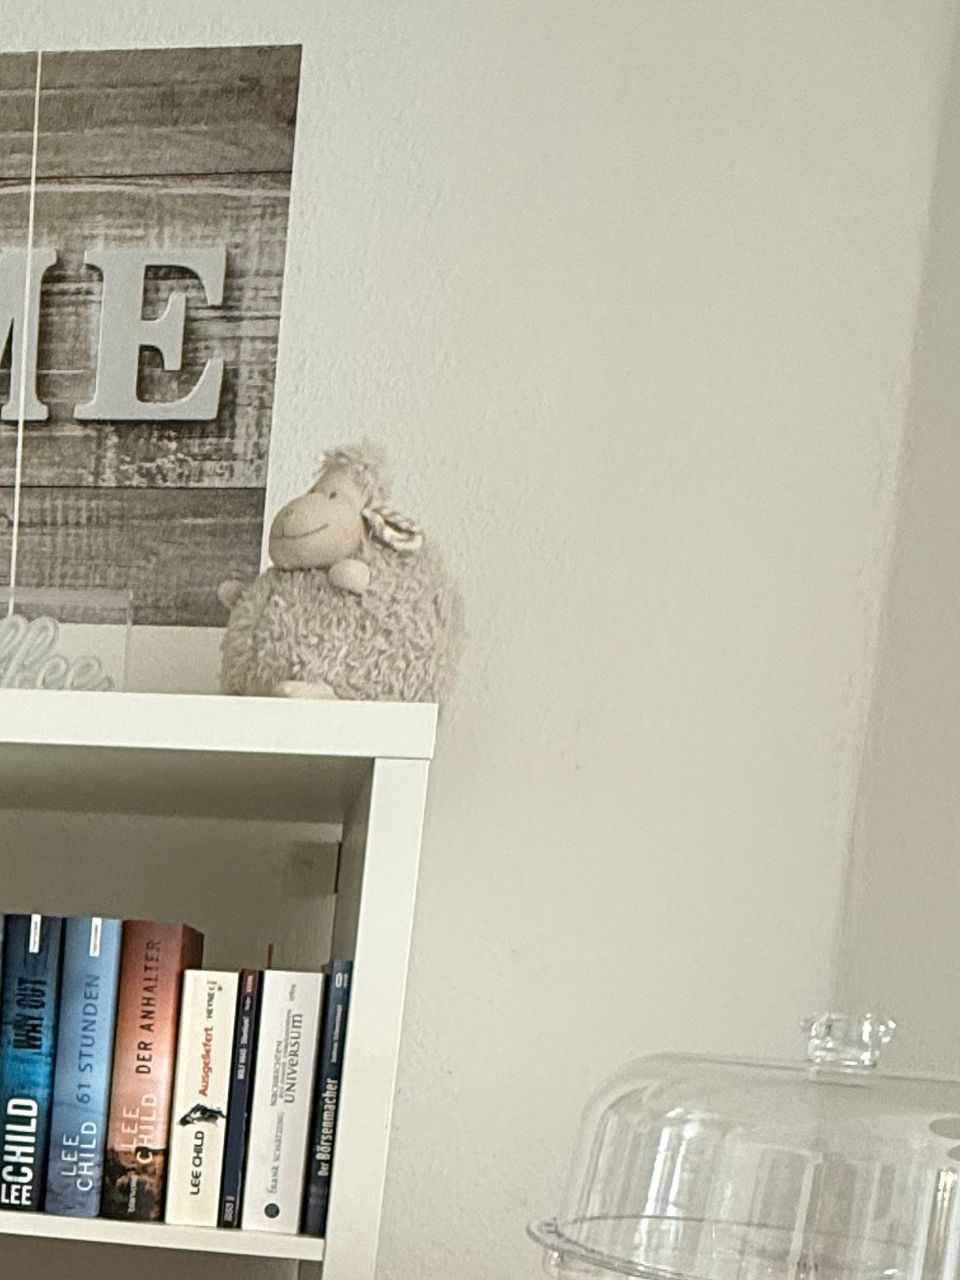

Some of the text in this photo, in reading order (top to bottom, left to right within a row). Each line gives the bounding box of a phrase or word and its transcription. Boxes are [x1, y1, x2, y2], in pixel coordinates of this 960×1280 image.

[77, 973, 100, 1073] STUNDEN
[121, 939, 162, 1164] LEE CHILD DER ANHALTER
[197, 1026, 215, 1097] Ausgeliefert
[75, 1083, 92, 1104] 61
[314, 1077, 339, 1161] Börsenmacher
[1, 1097, 39, 1184] CHILD
[60, 1133, 79, 1176] LEE
[76, 1121, 98, 1191] CHILD
[190, 1130, 205, 1168] CHILD
[0, 1183, 33, 1205] LEE
[189, 1171, 203, 1196] LEE
[317, 1161, 329, 1177] Der
